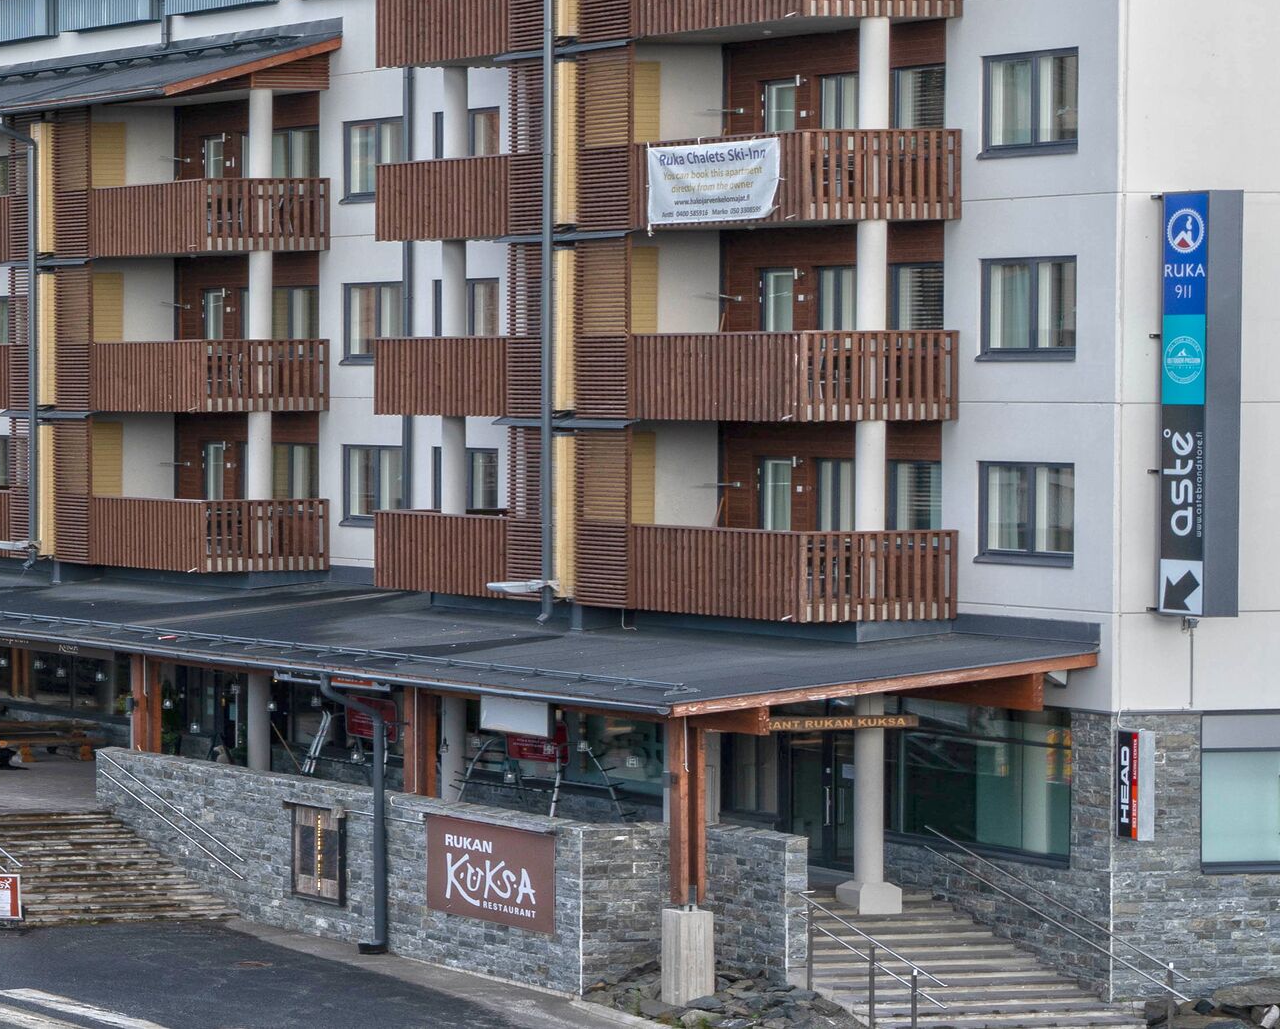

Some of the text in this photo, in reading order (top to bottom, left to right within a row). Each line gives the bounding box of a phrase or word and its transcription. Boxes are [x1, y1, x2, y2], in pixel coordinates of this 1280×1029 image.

[659, 148, 766, 166] Ruka Chalets Ski-Inn
[691, 168, 709, 179] book
[711, 167, 724, 177] this
[726, 166, 763, 180] apartment
[696, 182, 715, 192] from
[716, 182, 729, 191] the
[730, 180, 754, 190] owner
[1164, 264, 1205, 277] RUKA
[1175, 285, 1192, 299] 911
[804, 720, 853, 728] RUKAN
[857, 718, 906, 728] KUKSA
[1121, 746, 1130, 824] HEAD
[445, 834, 492, 854] RUKAN
[446, 852, 536, 907] KUKSA
[483, 901, 536, 919] RESTAURANT
